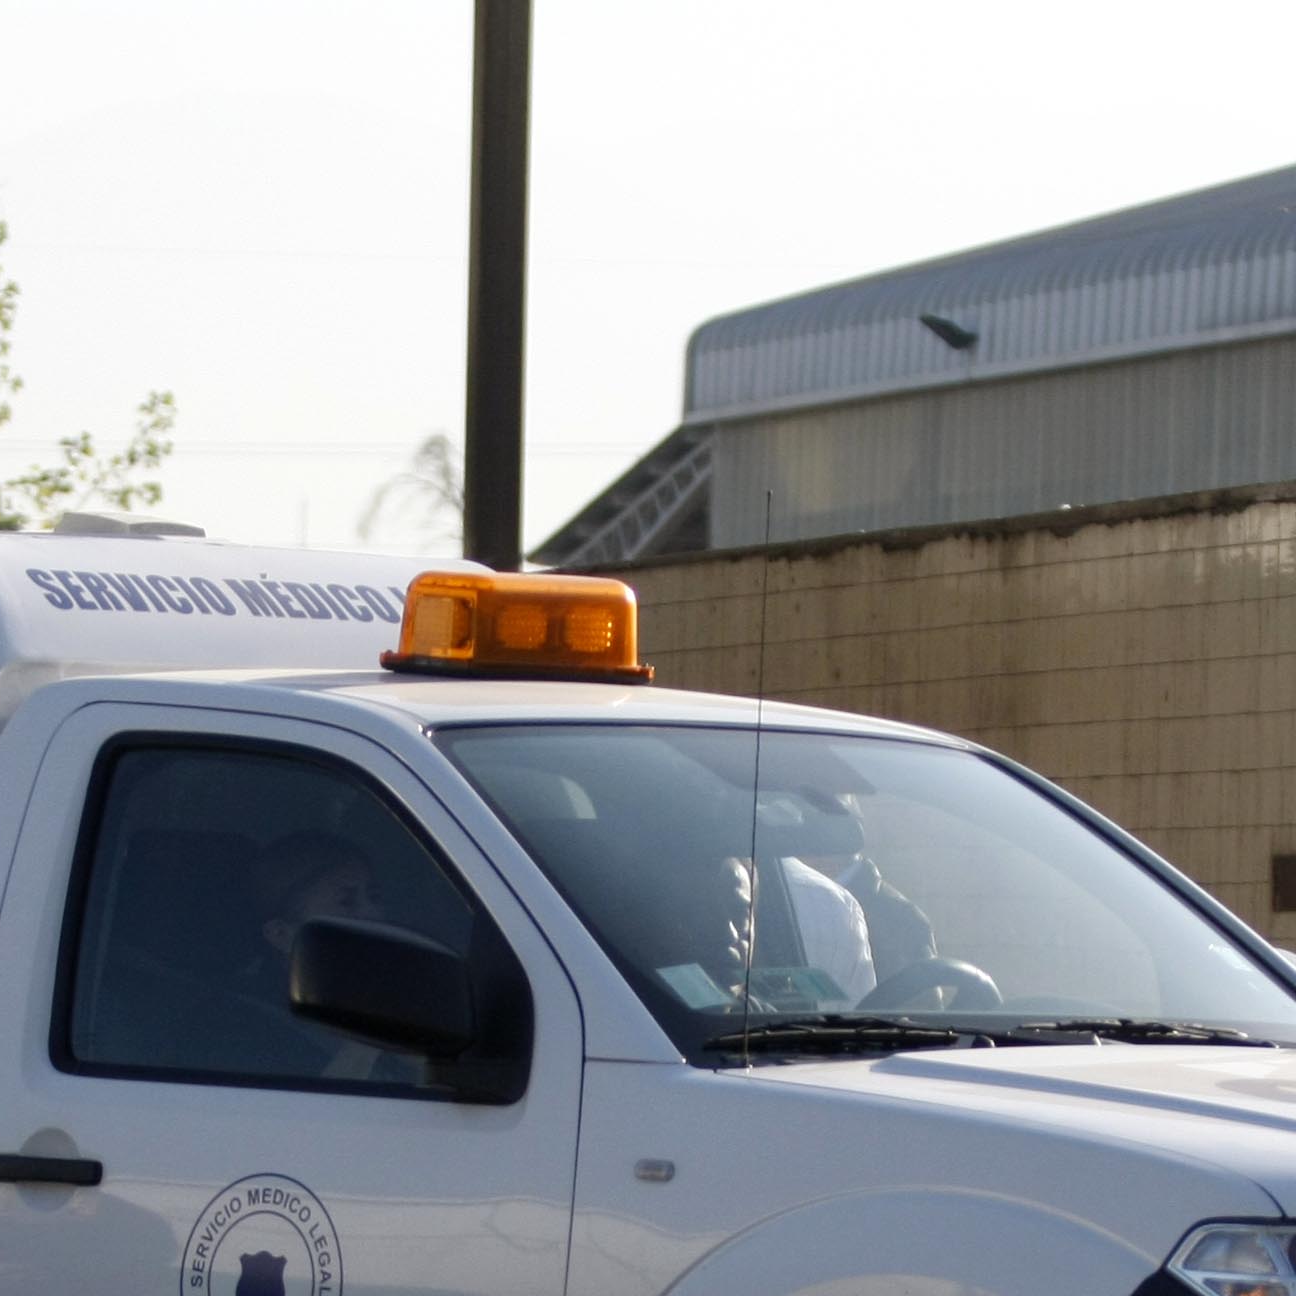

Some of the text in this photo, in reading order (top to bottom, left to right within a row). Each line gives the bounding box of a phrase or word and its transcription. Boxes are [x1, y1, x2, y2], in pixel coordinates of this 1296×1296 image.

[26, 568, 237, 616] SERVICIO
[191, 1197, 242, 1288] SERVICIO
[247, 1187, 311, 1223] MEDICO
